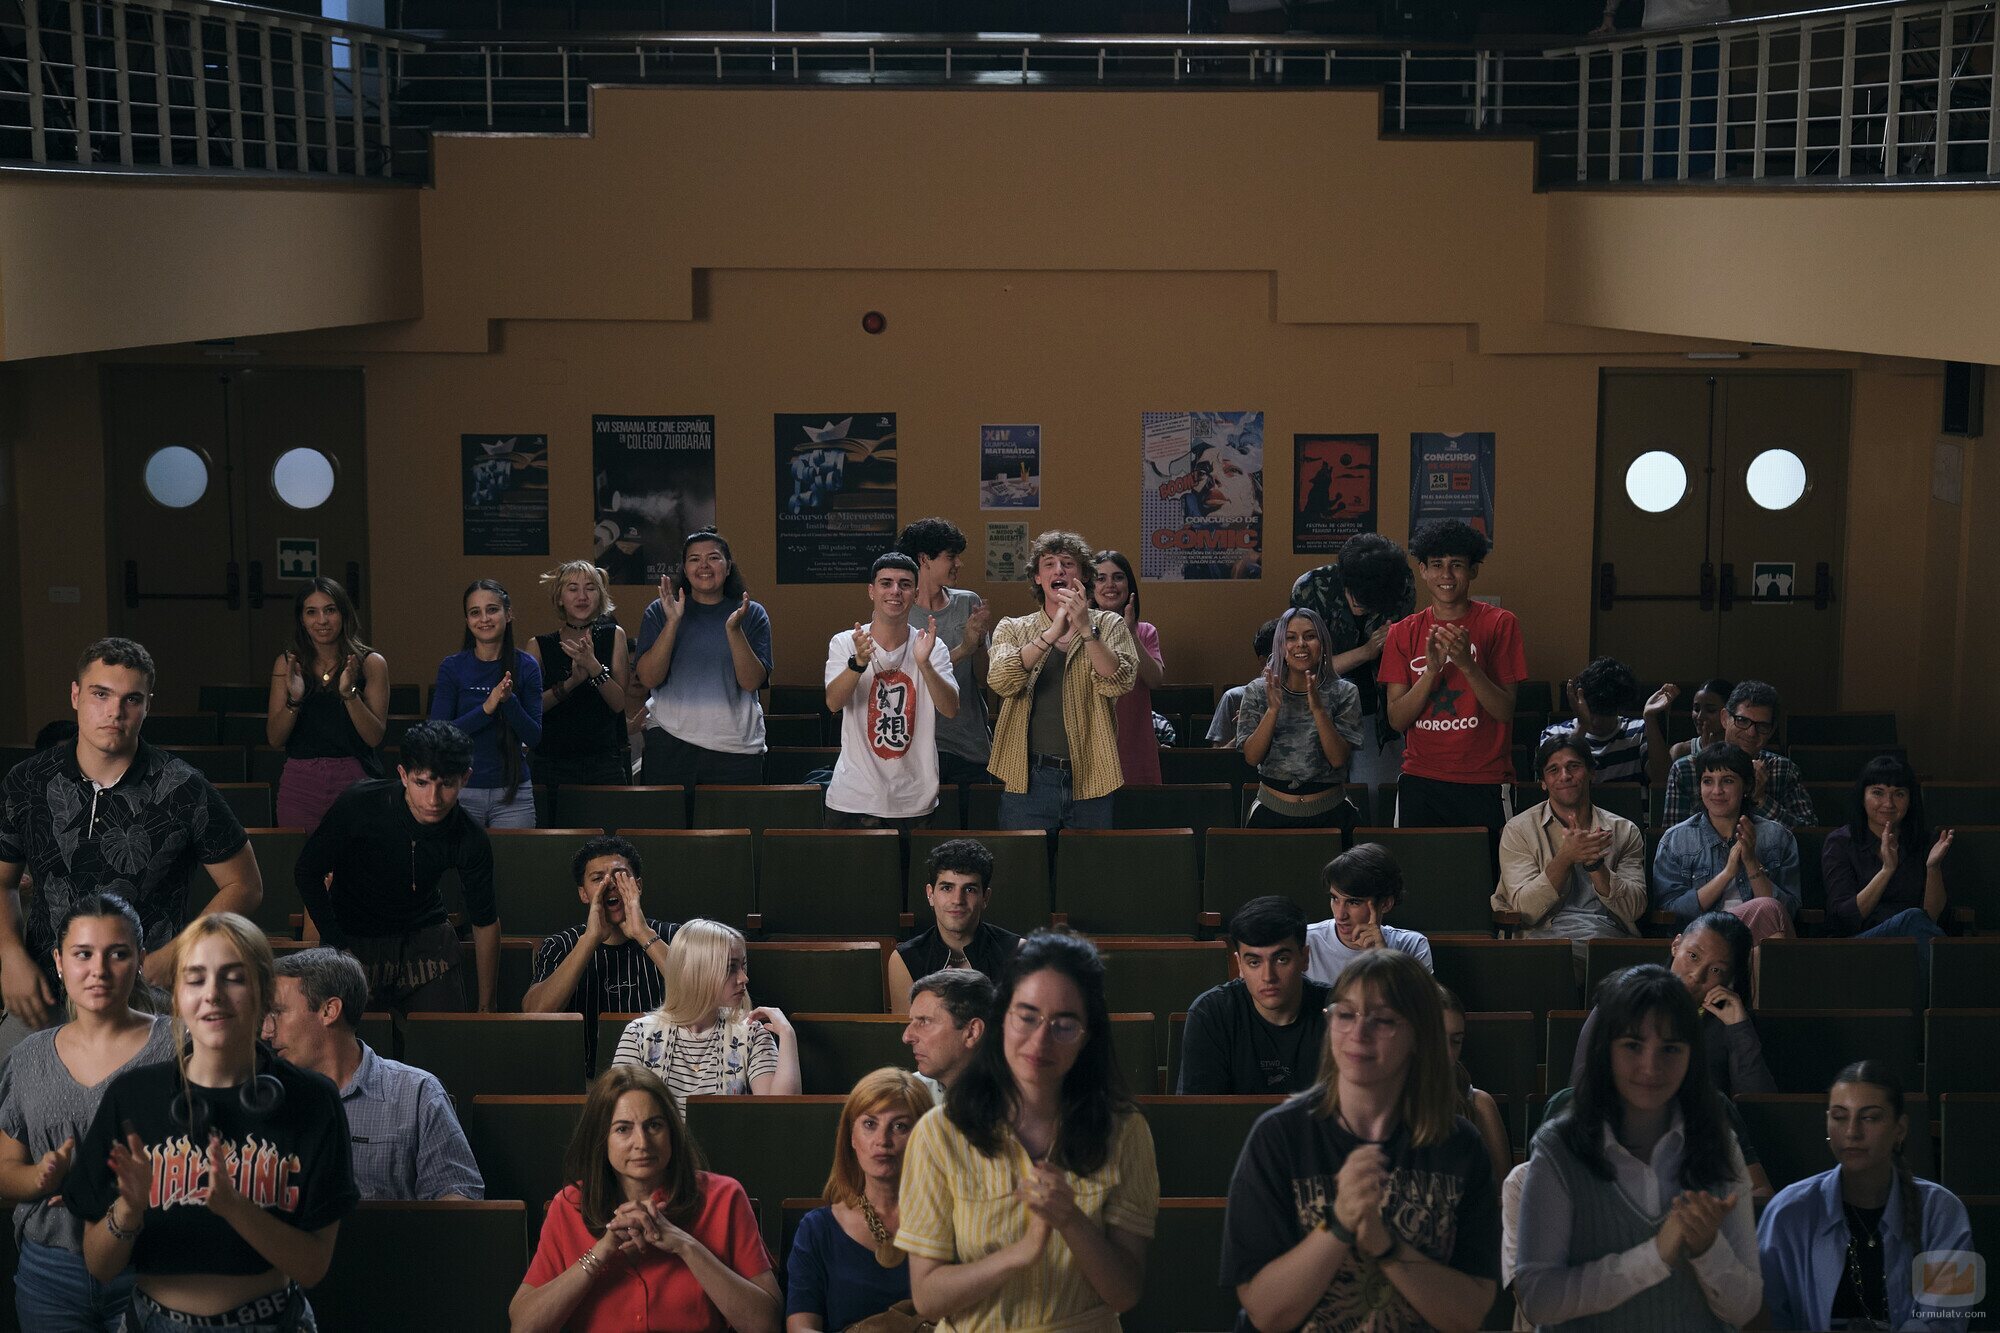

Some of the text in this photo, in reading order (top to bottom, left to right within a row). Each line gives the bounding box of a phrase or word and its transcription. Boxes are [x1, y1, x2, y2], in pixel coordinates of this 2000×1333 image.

[596, 419, 711, 432] XVI SEMANA DE CINE ESPAÑOL
[627, 434, 662, 449] COLEGIO
[664, 433, 711, 449] ZURBARÁN
[985, 430, 1010, 440] XIV
[1424, 453, 1476, 461] CONCURSO
[1159, 470, 1201, 499] BOOM!
[1433, 475, 1445, 483] 26
[779, 512, 822, 520] Concurso
[824, 512, 837, 520] de
[1151, 523, 1258, 550] CÓMIC
[657, 563, 666, 573] 22
[877, 681, 910, 748] 幻想
[1415, 716, 1479, 731] MOROCCO
